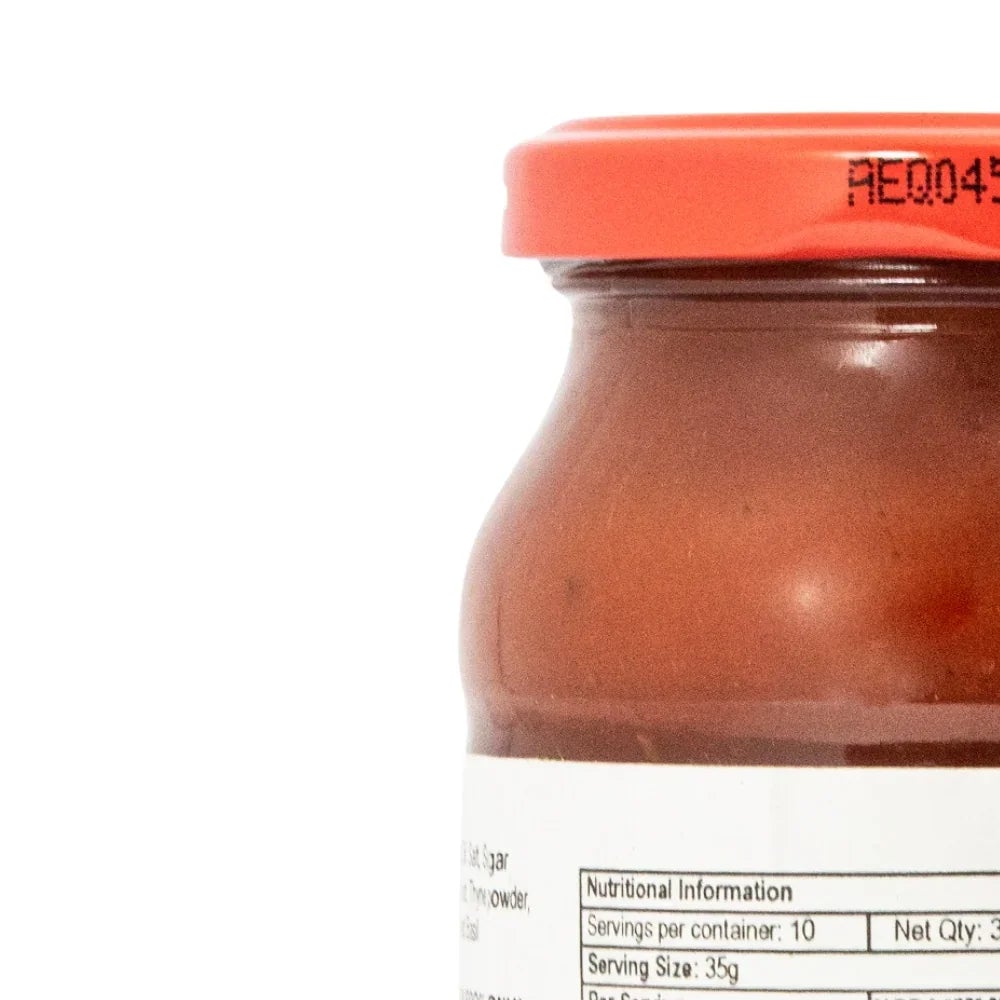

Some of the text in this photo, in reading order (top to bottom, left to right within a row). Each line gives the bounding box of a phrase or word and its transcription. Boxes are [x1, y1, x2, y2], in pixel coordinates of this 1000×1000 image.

[587, 876, 792, 903] Nutritional Information
[588, 913, 815, 943] Servings per container: 10
[895, 918, 930, 942] Net
[939, 918, 982, 947] Qty:
[588, 952, 739, 984] Serving Size: 35g
